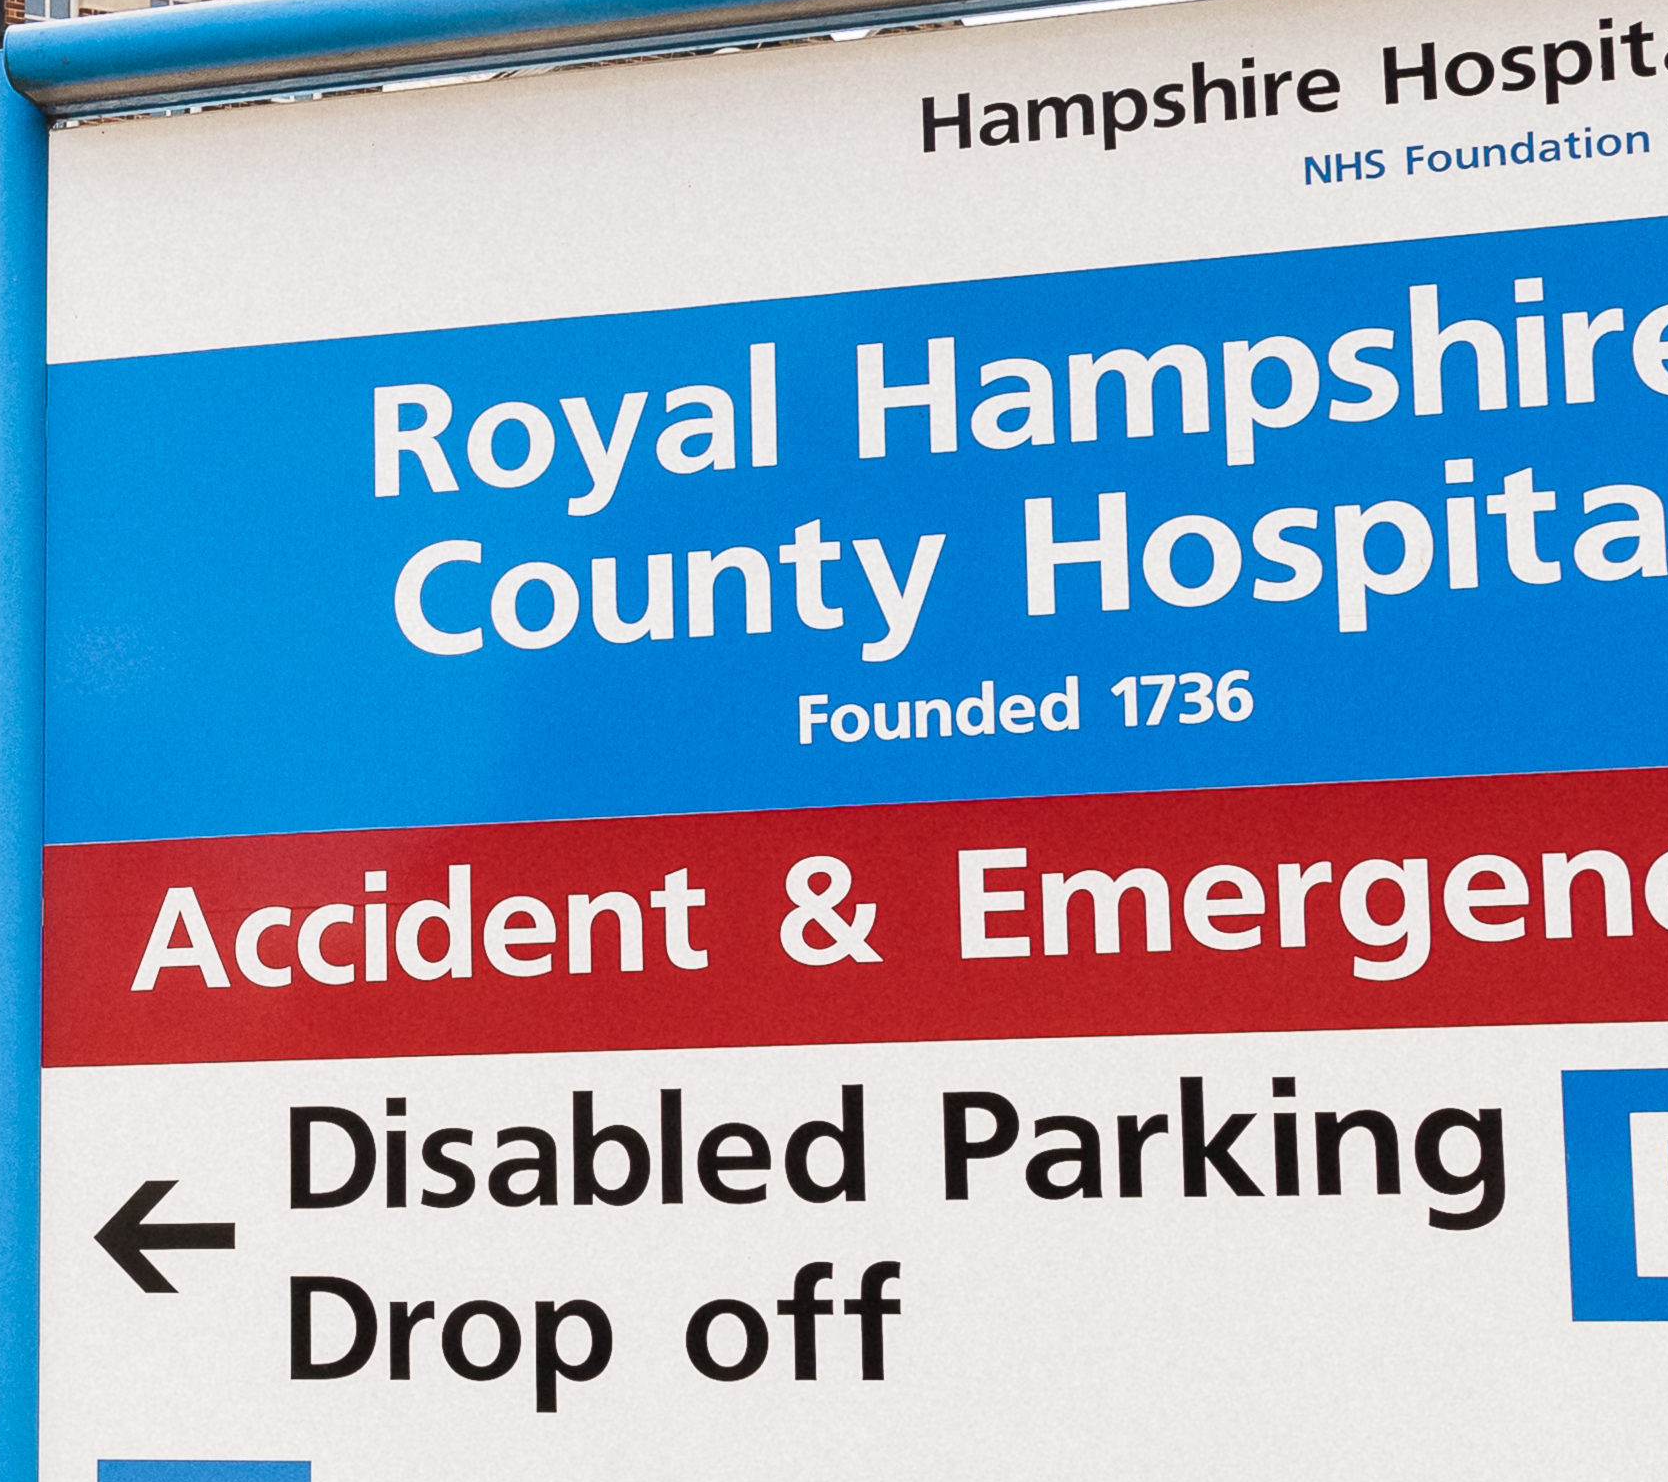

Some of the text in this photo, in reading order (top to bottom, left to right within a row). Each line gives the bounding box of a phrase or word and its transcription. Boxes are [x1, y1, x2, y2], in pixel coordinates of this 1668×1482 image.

[921, 57, 1341, 153] Hampshire
[1303, 149, 1386, 185] NHS
[1406, 127, 1651, 175] Foundation
[373, 342, 778, 518] Royal
[394, 518, 947, 663] County
[798, 669, 1254, 745] Founded 1736
[130, 863, 709, 992] Accident
[780, 855, 884, 966] &
[290, 1076, 1506, 1231] Disabled Parking
[290, 1260, 901, 1413] Drop off
